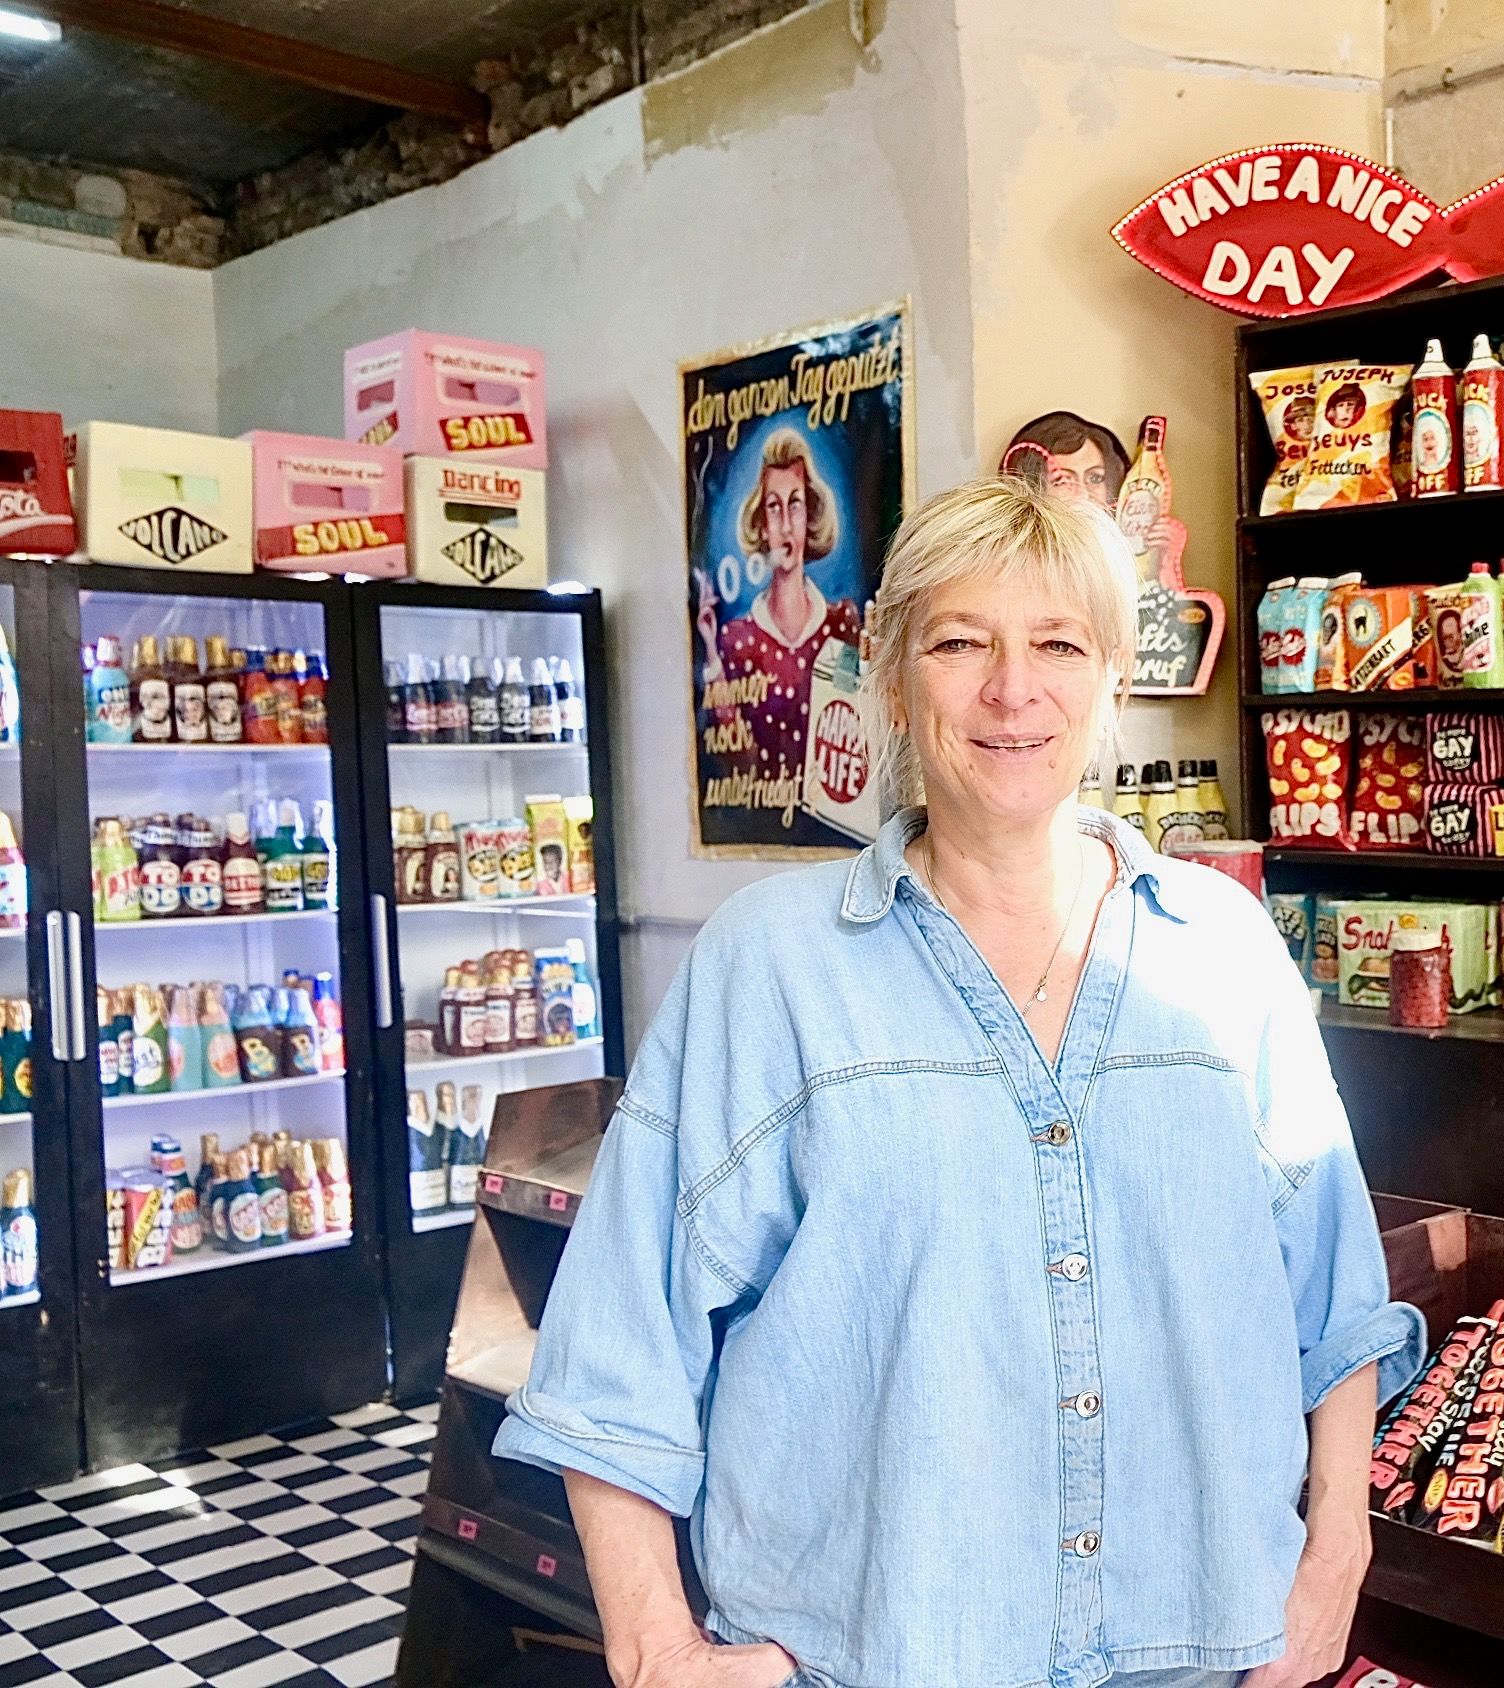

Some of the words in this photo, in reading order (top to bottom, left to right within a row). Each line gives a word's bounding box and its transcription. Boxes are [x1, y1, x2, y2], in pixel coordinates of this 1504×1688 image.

[1158, 155, 1282, 238] HAVE
[1288, 155, 1321, 204] A
[1326, 164, 1434, 249] NICE
[1201, 240, 1355, 307] DAY
[790, 353, 826, 431] Tag
[1264, 384, 1318, 400] JOSE
[1464, 382, 1490, 401] UCK
[445, 415, 527, 450] SOUL
[1465, 467, 1486, 485] FF
[119, 508, 227, 562] VOLCANO
[293, 519, 389, 555] SOUL
[443, 529, 525, 583] VOLCANO
[704, 708, 754, 754] noch
[816, 702, 865, 752] HAPPY
[1261, 708, 1351, 743] PSYCHO
[1357, 712, 1425, 747] PSYC
[1433, 735, 1474, 759] GAY
[818, 744, 864, 797] LIFE
[1351, 810, 1422, 844] FLIP
[1430, 807, 1471, 838] GAY
[1369, 1325, 1489, 1491] TOGETHER
